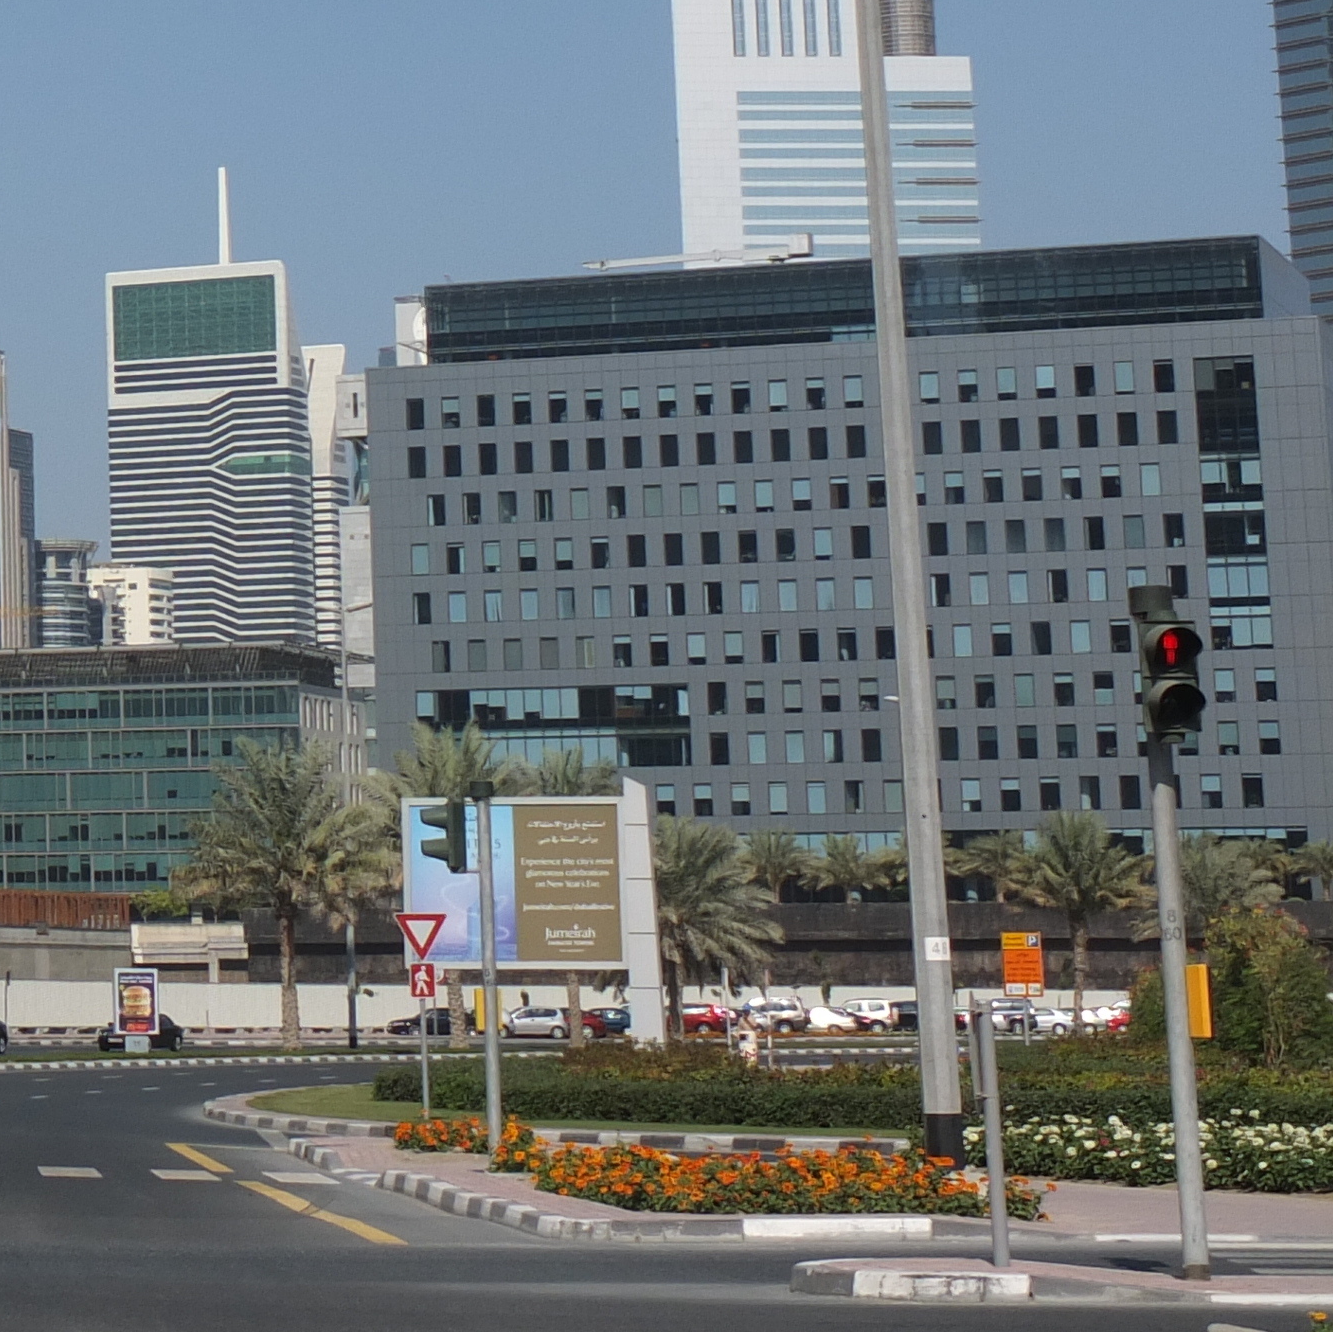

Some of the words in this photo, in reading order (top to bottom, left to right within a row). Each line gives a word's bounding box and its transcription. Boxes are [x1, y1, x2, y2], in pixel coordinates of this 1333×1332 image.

[520, 857, 561, 867] Experience
[546, 879, 564, 888] New
[545, 923, 596, 941] Jumeirah
